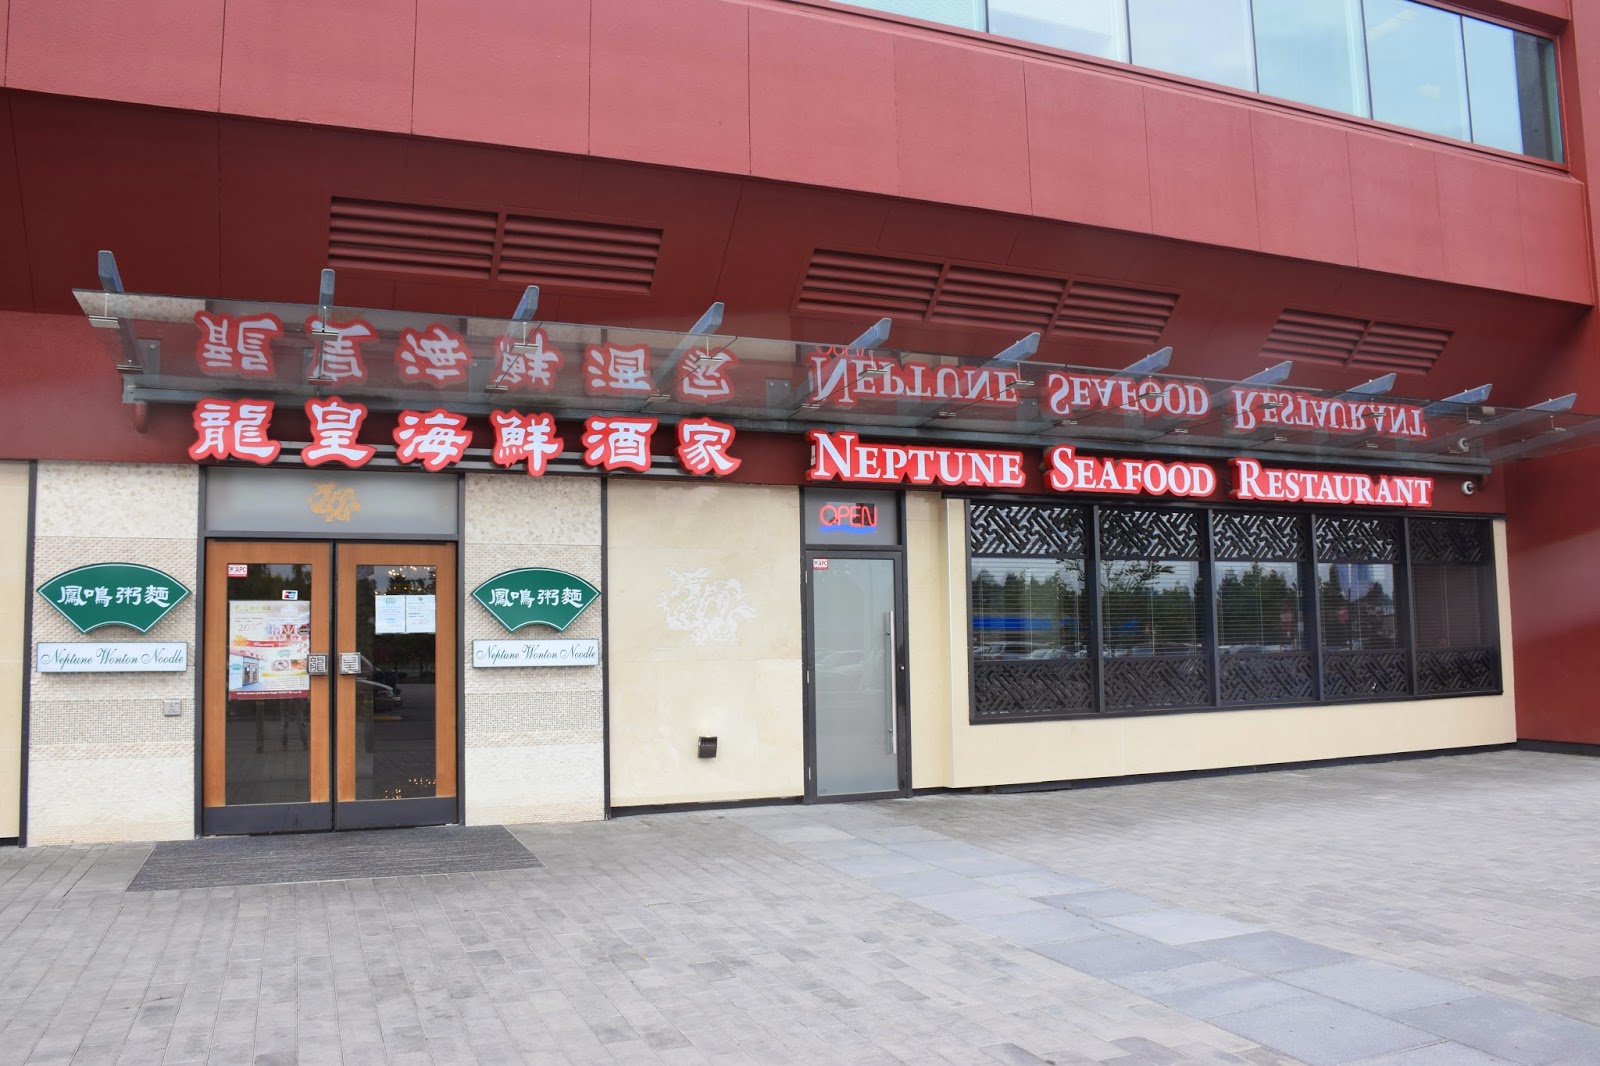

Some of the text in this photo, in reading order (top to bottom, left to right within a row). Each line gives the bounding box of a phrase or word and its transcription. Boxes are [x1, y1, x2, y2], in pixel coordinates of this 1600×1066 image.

[194, 401, 735, 471] 龍皇海鮮酒家
[813, 432, 1432, 505] NEPTUNE SEAFOOD RESTAURANT
[819, 504, 878, 527] OPEN
[57, 584, 171, 608] 鳳鳴粥麵
[488, 587, 584, 608] 鳳鳴粥麵
[40, 647, 184, 670] Neptune Wonton Noodle
[476, 644, 596, 665] Neptune Wonton Noodle
